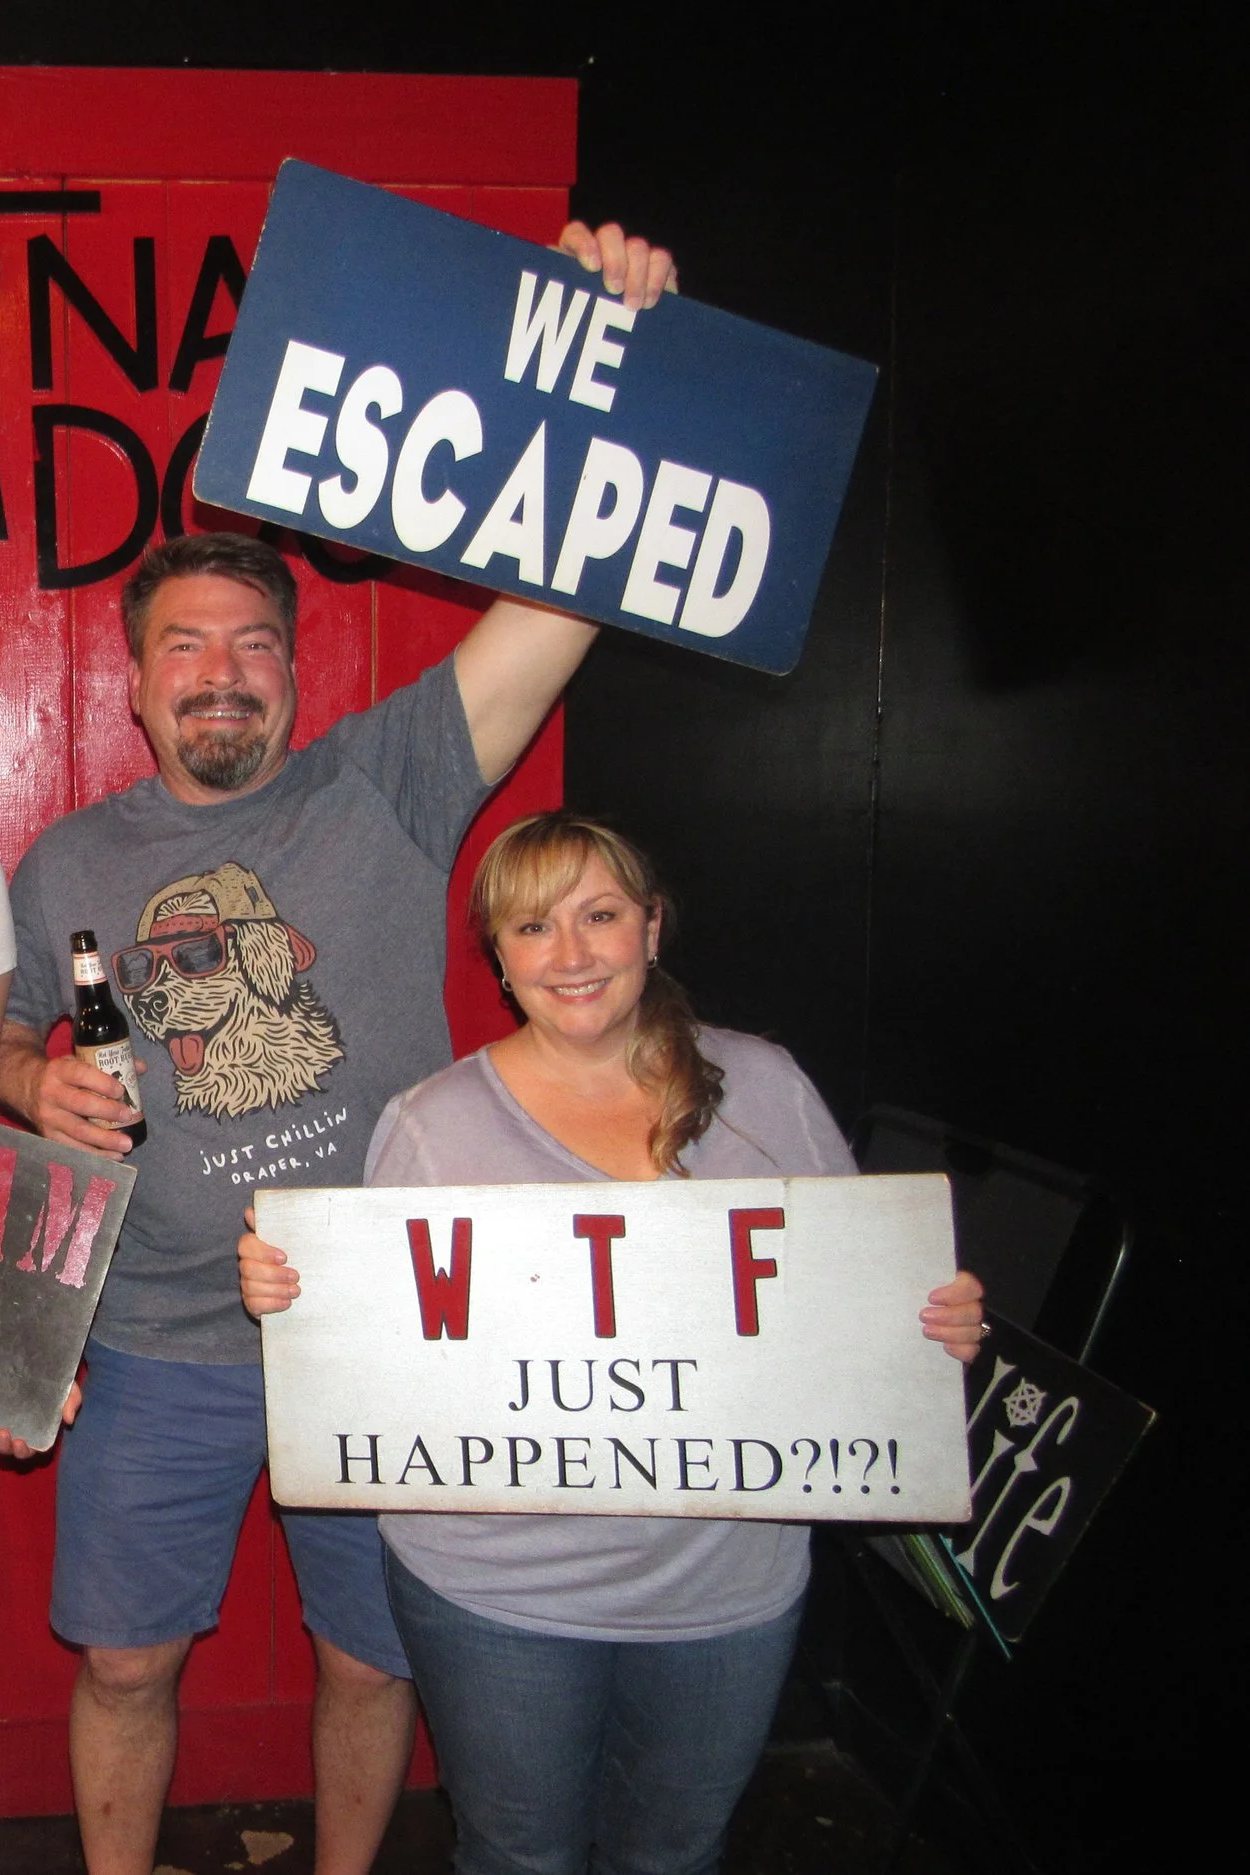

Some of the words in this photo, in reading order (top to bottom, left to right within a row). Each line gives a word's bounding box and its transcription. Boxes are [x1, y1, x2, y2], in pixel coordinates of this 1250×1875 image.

[504, 270, 637, 413] WE
[246, 340, 771, 639] ESCAPED
[315, 1141, 337, 1159] VA
[507, 1358, 699, 1413] JUST
[331, 1433, 902, 1496] HAPPENED?!?!
